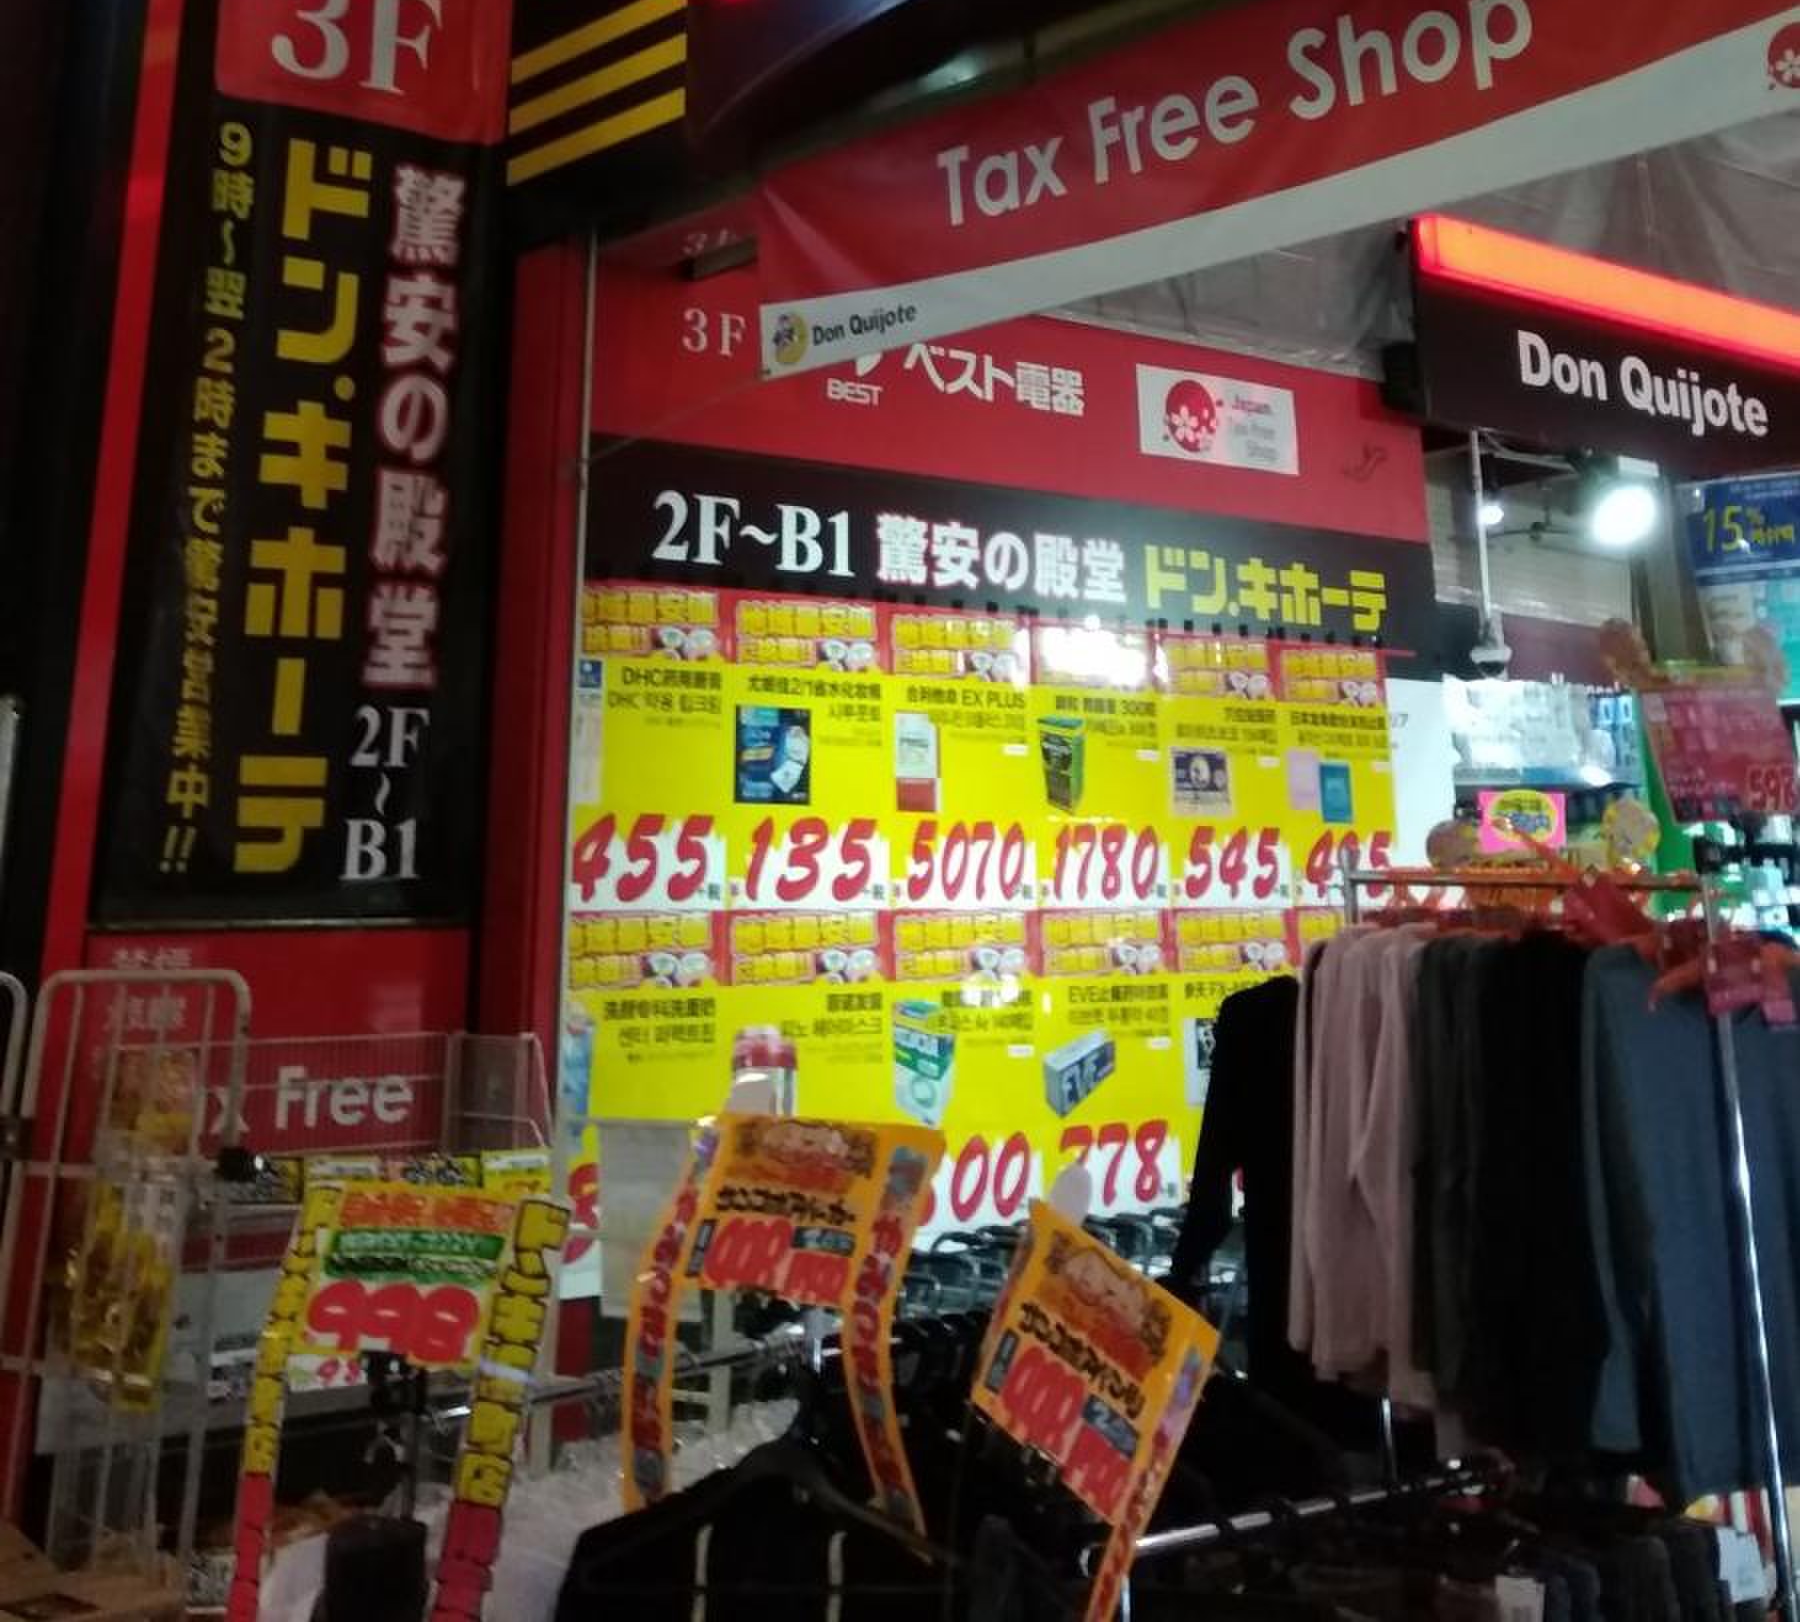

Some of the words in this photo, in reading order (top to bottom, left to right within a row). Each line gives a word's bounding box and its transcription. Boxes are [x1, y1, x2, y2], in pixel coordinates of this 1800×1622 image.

[936, 134, 1067, 228] Tax
[1087, 72, 1259, 185] Free
[681, 307, 747, 357] 3F
[811, 321, 846, 347] Don
[849, 303, 918, 336] Quijote
[827, 378, 884, 406] BEST
[903, 343, 1085, 418] ベスト電器
[1517, 330, 1609, 404] Don
[1620, 351, 1769, 442] Quijote
[362, 163, 467, 687] 驚安の殿堂
[876, 512, 1127, 604] 驚安の殿堂
[572, 812, 716, 903] 455
[745, 815, 879, 903] 135
[906, 819, 1026, 902] 5070
[1053, 822, 1160, 902] 1780
[1184, 824, 1281, 901] 545
[275, 1066, 414, 1130] Free
[1059, 1119, 1168, 1206] 778
